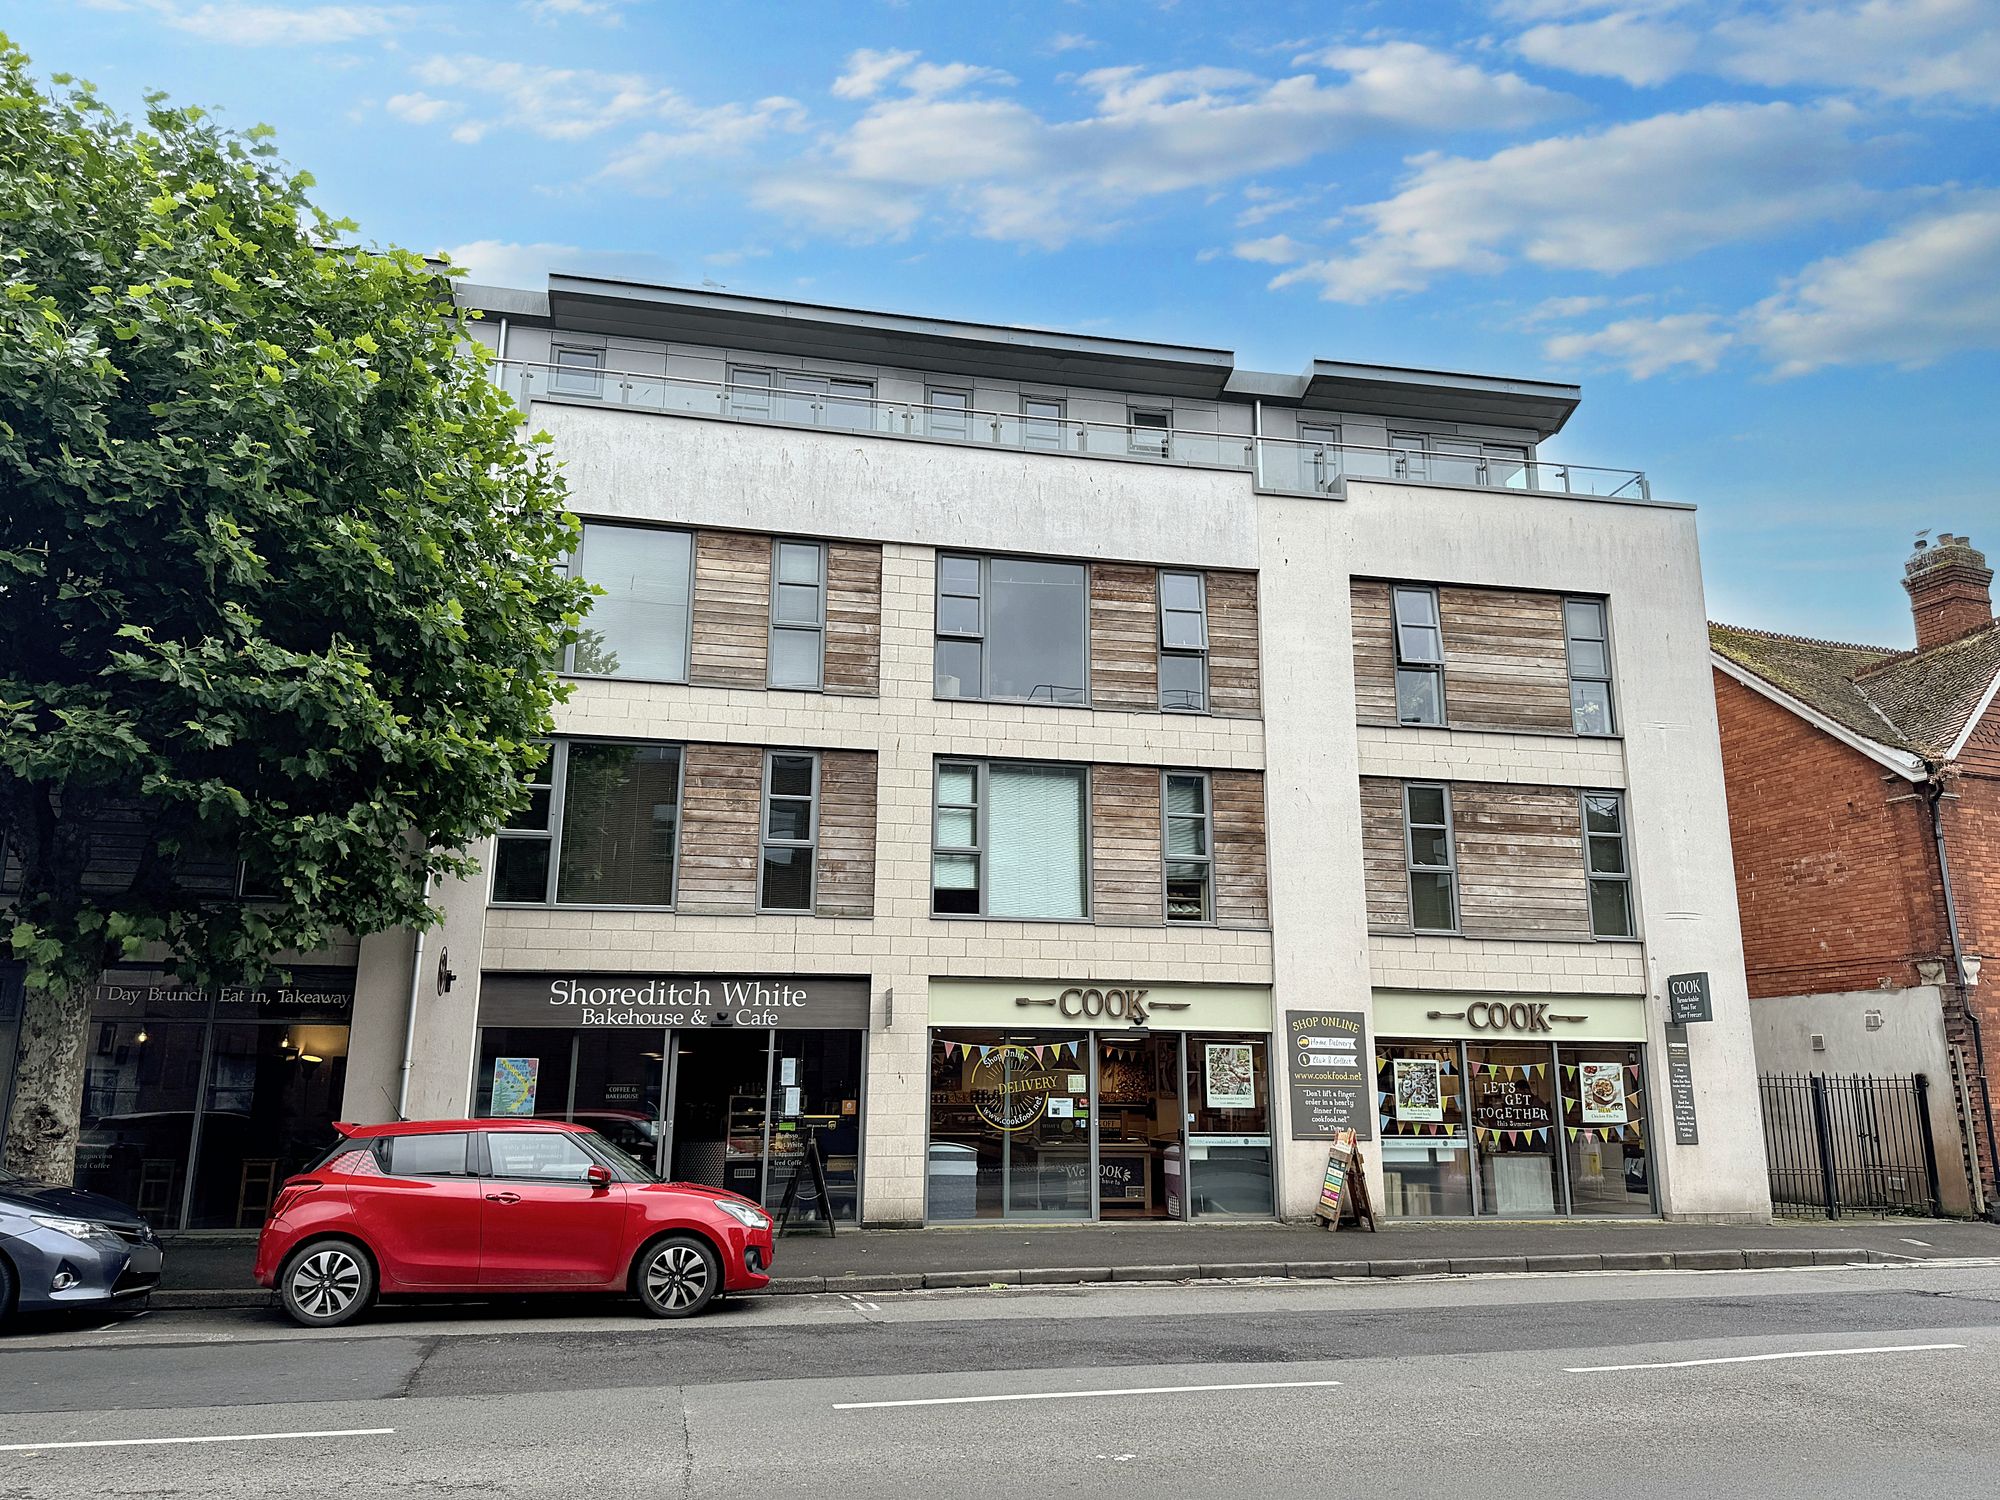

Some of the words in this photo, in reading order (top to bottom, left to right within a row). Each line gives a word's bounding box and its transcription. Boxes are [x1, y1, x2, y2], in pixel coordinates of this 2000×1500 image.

[550, 980, 711, 1006] Shoreditch
[721, 981, 807, 1007] White
[1672, 979, 1701, 995] COOK
[108, 987, 141, 1006] Day
[149, 987, 208, 1001] Brunch
[219, 988, 244, 1002] Eat
[278, 989, 351, 1009] Takeaway
[1059, 988, 1150, 1020] COOK
[581, 1008, 684, 1026] Bakehouse
[691, 1008, 708, 1026] &
[735, 1008, 778, 1027] Cafe
[1467, 1001, 1552, 1032] COOK
[1292, 1016, 1319, 1032] SHOP
[1321, 1016, 1360, 1033] ONLINE
[1311, 1038, 1327, 1046] Home
[1328, 1038, 1352, 1049] Delivery
[983, 1053, 1003, 1069] Shop
[1003, 1049, 1029, 1062] Online
[1294, 1071, 1362, 1081] www.cookfood.net
[998, 1075, 1058, 1095] DELIVERY
[1483, 1081, 1516, 1095] LET'S
[1322, 1089, 1332, 1097] lift
[1504, 1093, 1532, 1106] GET
[1305, 1098, 1322, 1106] order
[1333, 1098, 1354, 1108] hearty
[1313, 1106, 1333, 1114] dinner
[1333, 1106, 1347, 1115] from
[1477, 1107, 1549, 1120] TOGETHER
[89, 1161, 111, 1169] Coffee
[787, 1159, 802, 1167] Coffe
[1098, 1163, 1123, 1179] OOK
